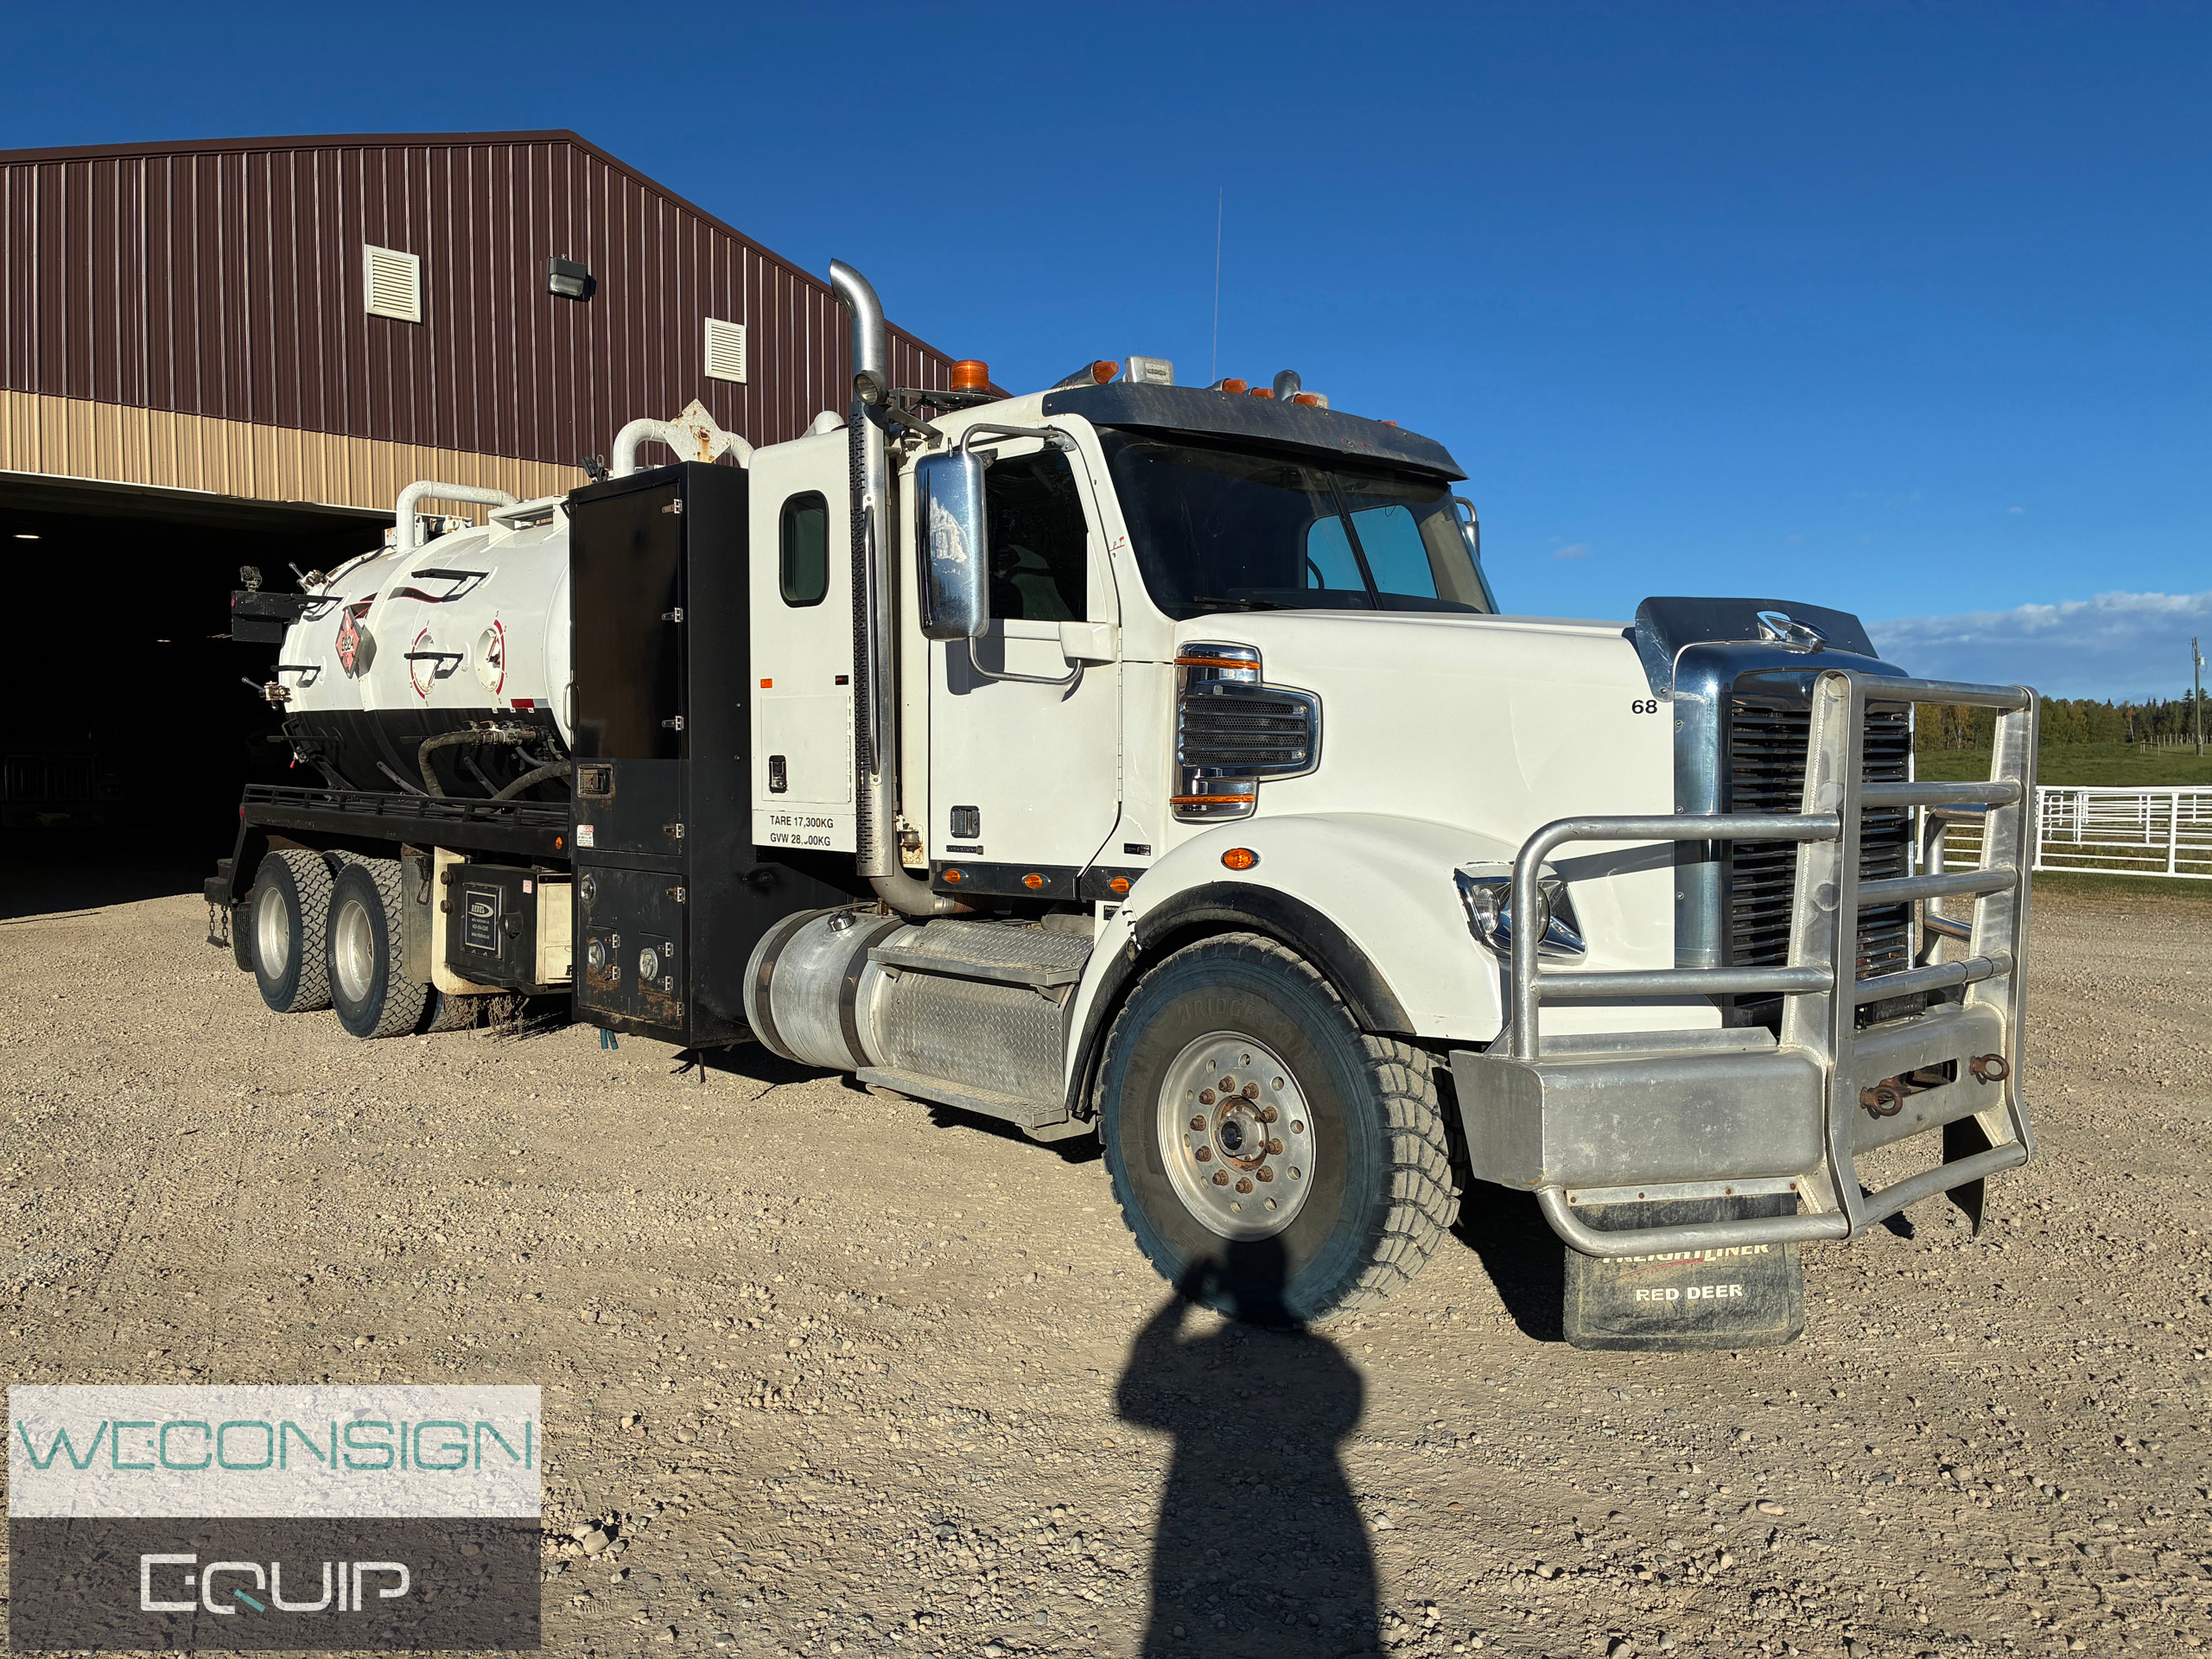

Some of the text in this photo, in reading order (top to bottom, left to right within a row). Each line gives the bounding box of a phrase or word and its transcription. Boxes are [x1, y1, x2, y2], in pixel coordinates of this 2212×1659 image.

[1631, 699, 1658, 715] 68
[770, 815, 834, 829] TARE 17,300KG
[770, 832, 789, 843] GVW
[1636, 1284, 1744, 1301] RED DEER
